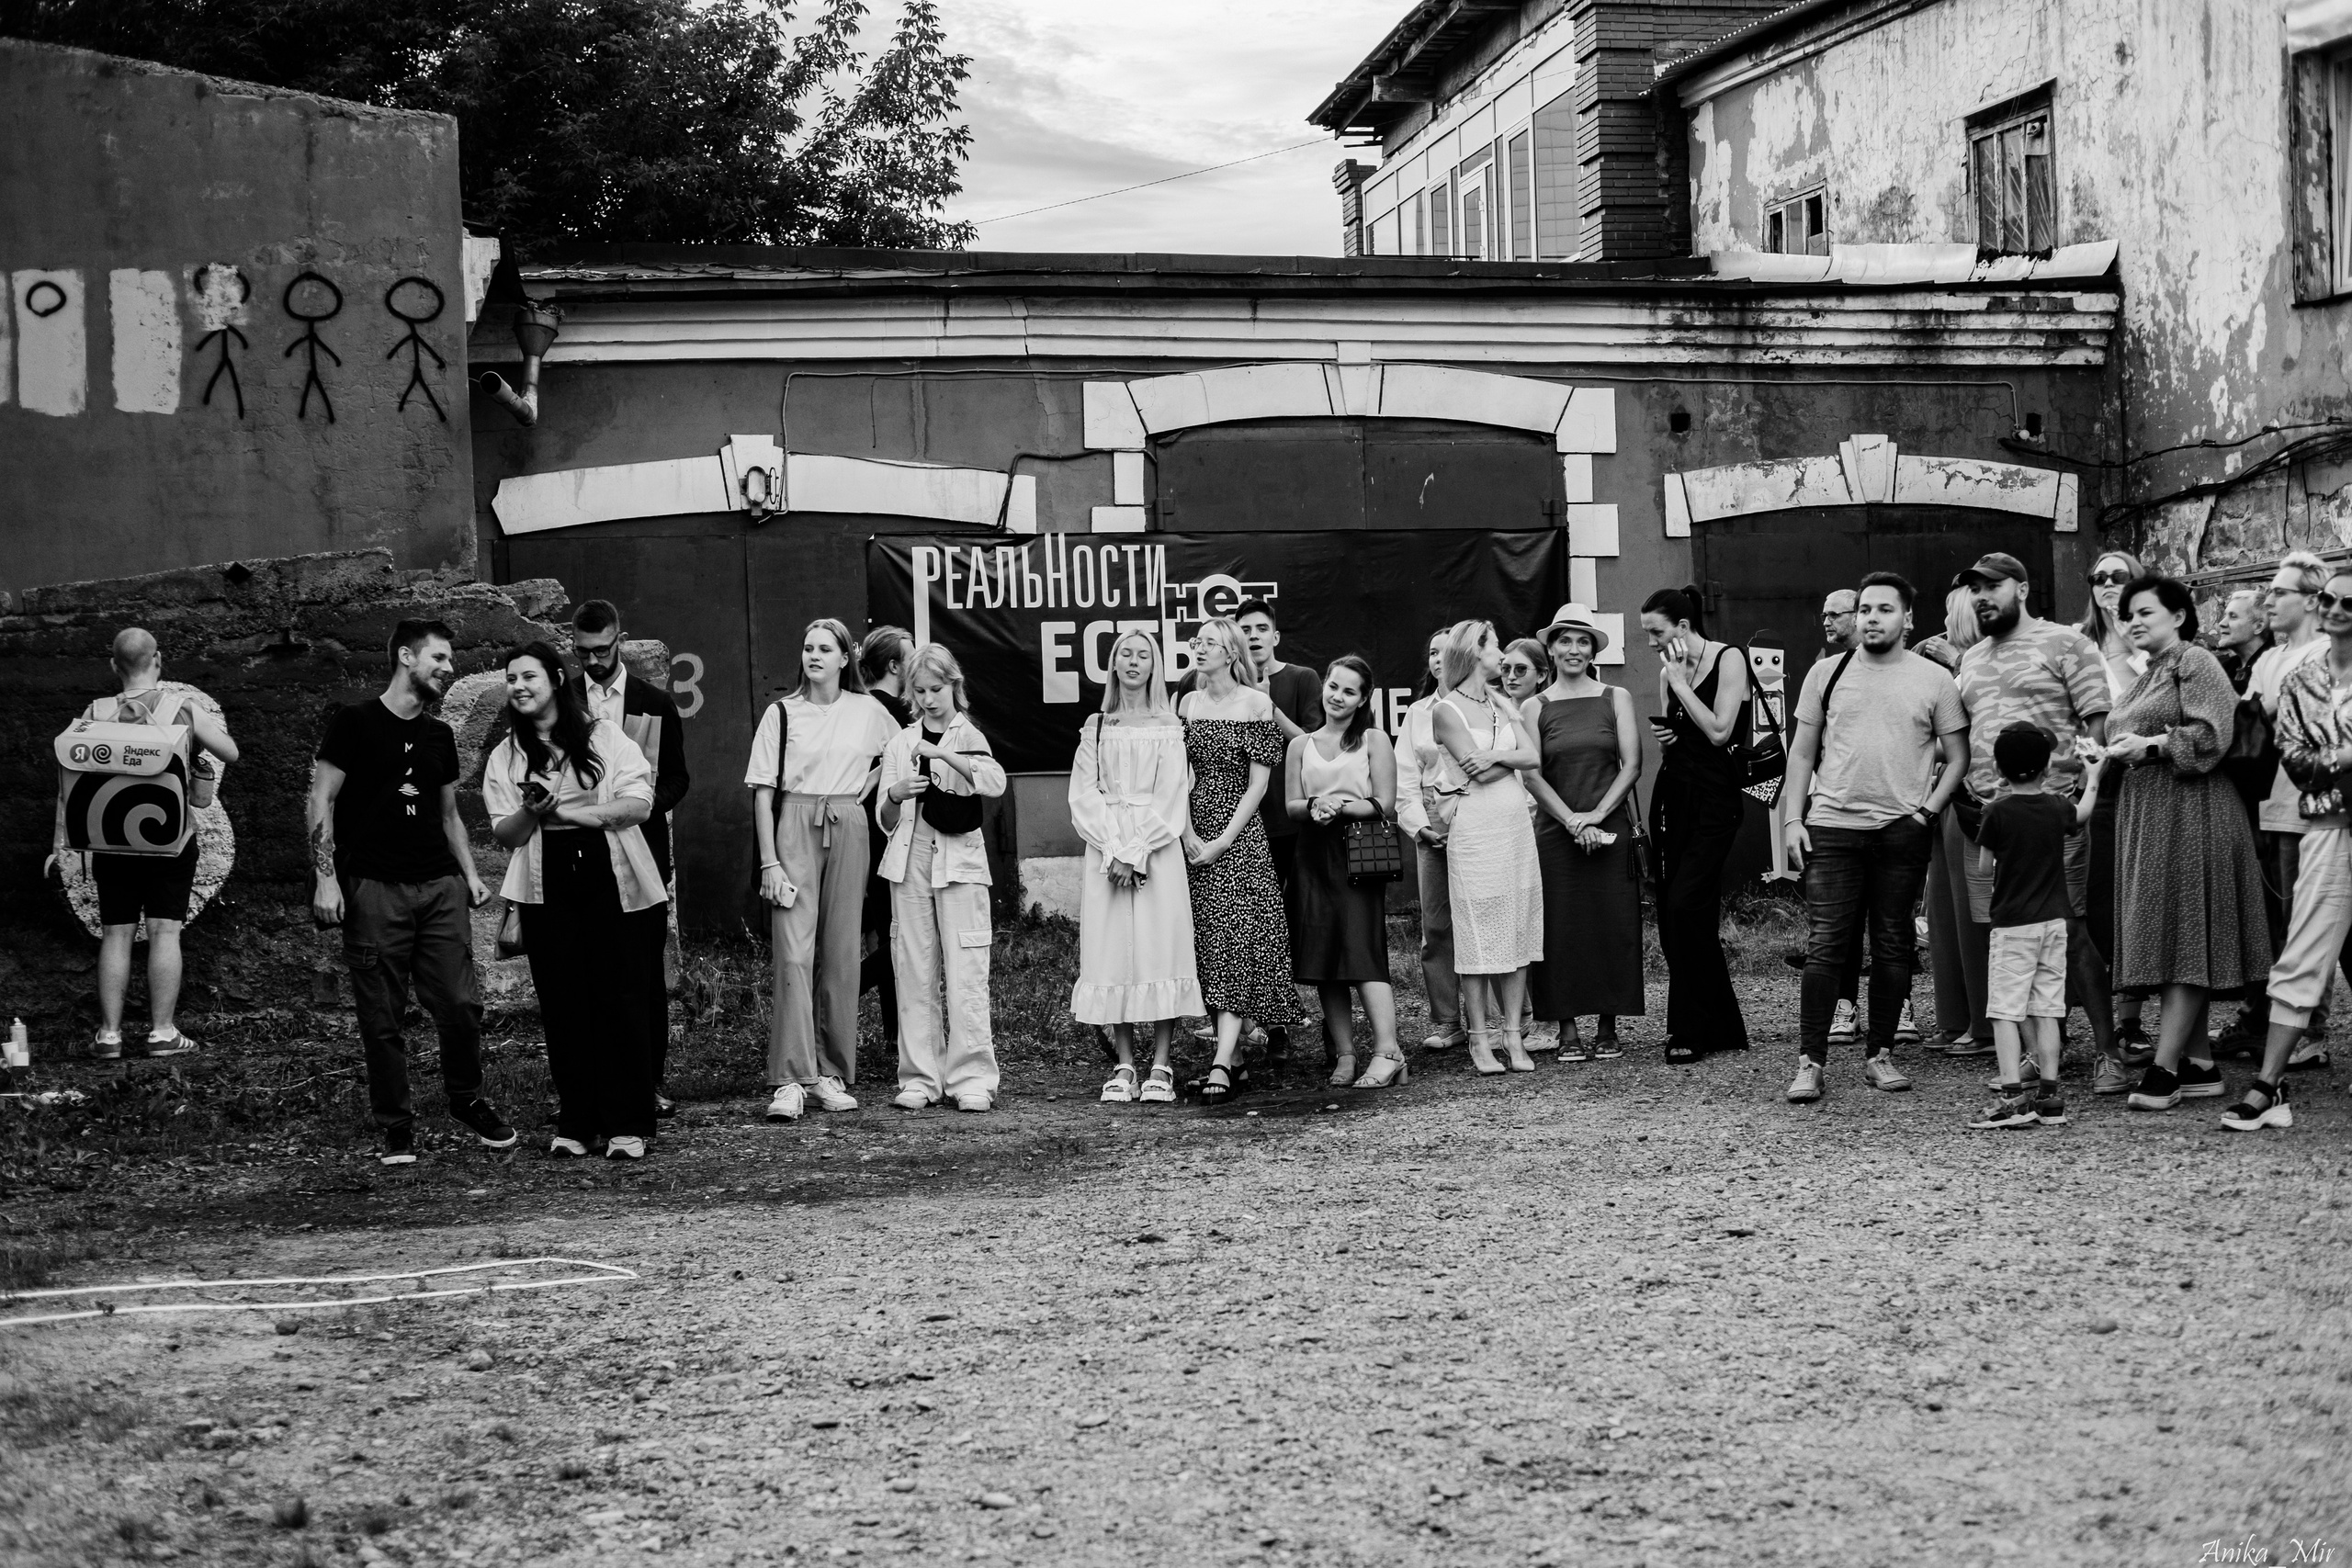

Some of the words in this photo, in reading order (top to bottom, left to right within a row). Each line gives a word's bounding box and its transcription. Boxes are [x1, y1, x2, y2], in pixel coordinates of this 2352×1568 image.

[911, 533, 1165, 650] РЕАЛЬНОСТИ
[672, 652, 704, 719] 3
[122, 755, 142, 766] Еда
[124, 745, 161, 757] Яндекс
